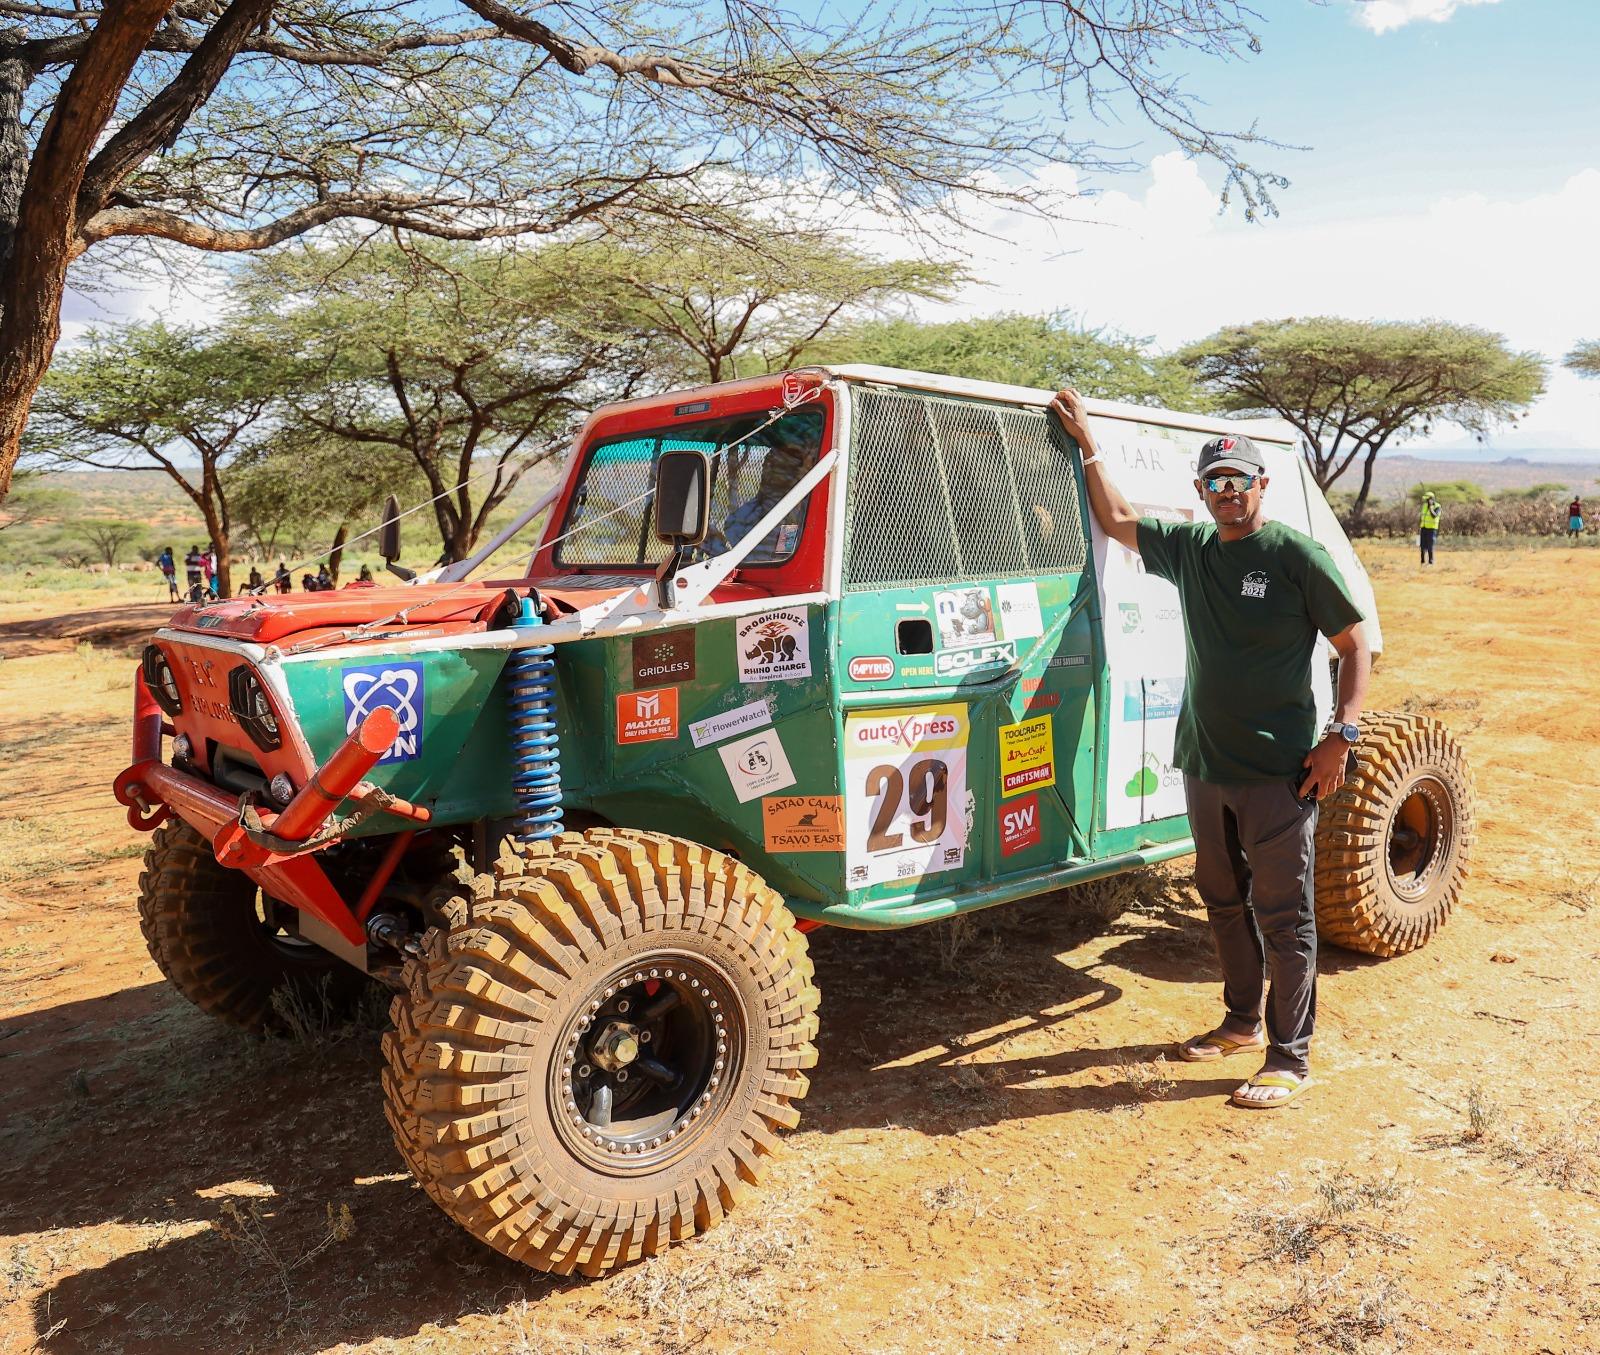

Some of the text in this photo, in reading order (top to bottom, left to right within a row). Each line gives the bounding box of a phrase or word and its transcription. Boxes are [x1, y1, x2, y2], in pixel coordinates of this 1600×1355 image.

[1241, 586, 1265, 597] 2025
[739, 612, 806, 638] BROOKHOUSE
[938, 644, 1015, 671] SOLEX
[638, 661, 690, 677] GRIDLESS
[743, 662, 806, 675] RHINO CHARGE
[852, 662, 890, 675] PAPYRUS
[901, 666, 934, 677] OPEN HERE
[190, 694, 239, 724] EXPLORE
[625, 717, 671, 730] MAXXIS
[712, 708, 767, 733] FlowerWatch
[858, 716, 954, 747] autoXpress
[1004, 722, 1046, 740] TOOLCRAFTS
[1006, 767, 1050, 787] CRAFTSMAN
[768, 797, 841, 815] SATAO CAMP
[865, 759, 949, 853] 29
[1003, 805, 1034, 835] SW
[771, 834, 842, 845] TSAVO EAST
